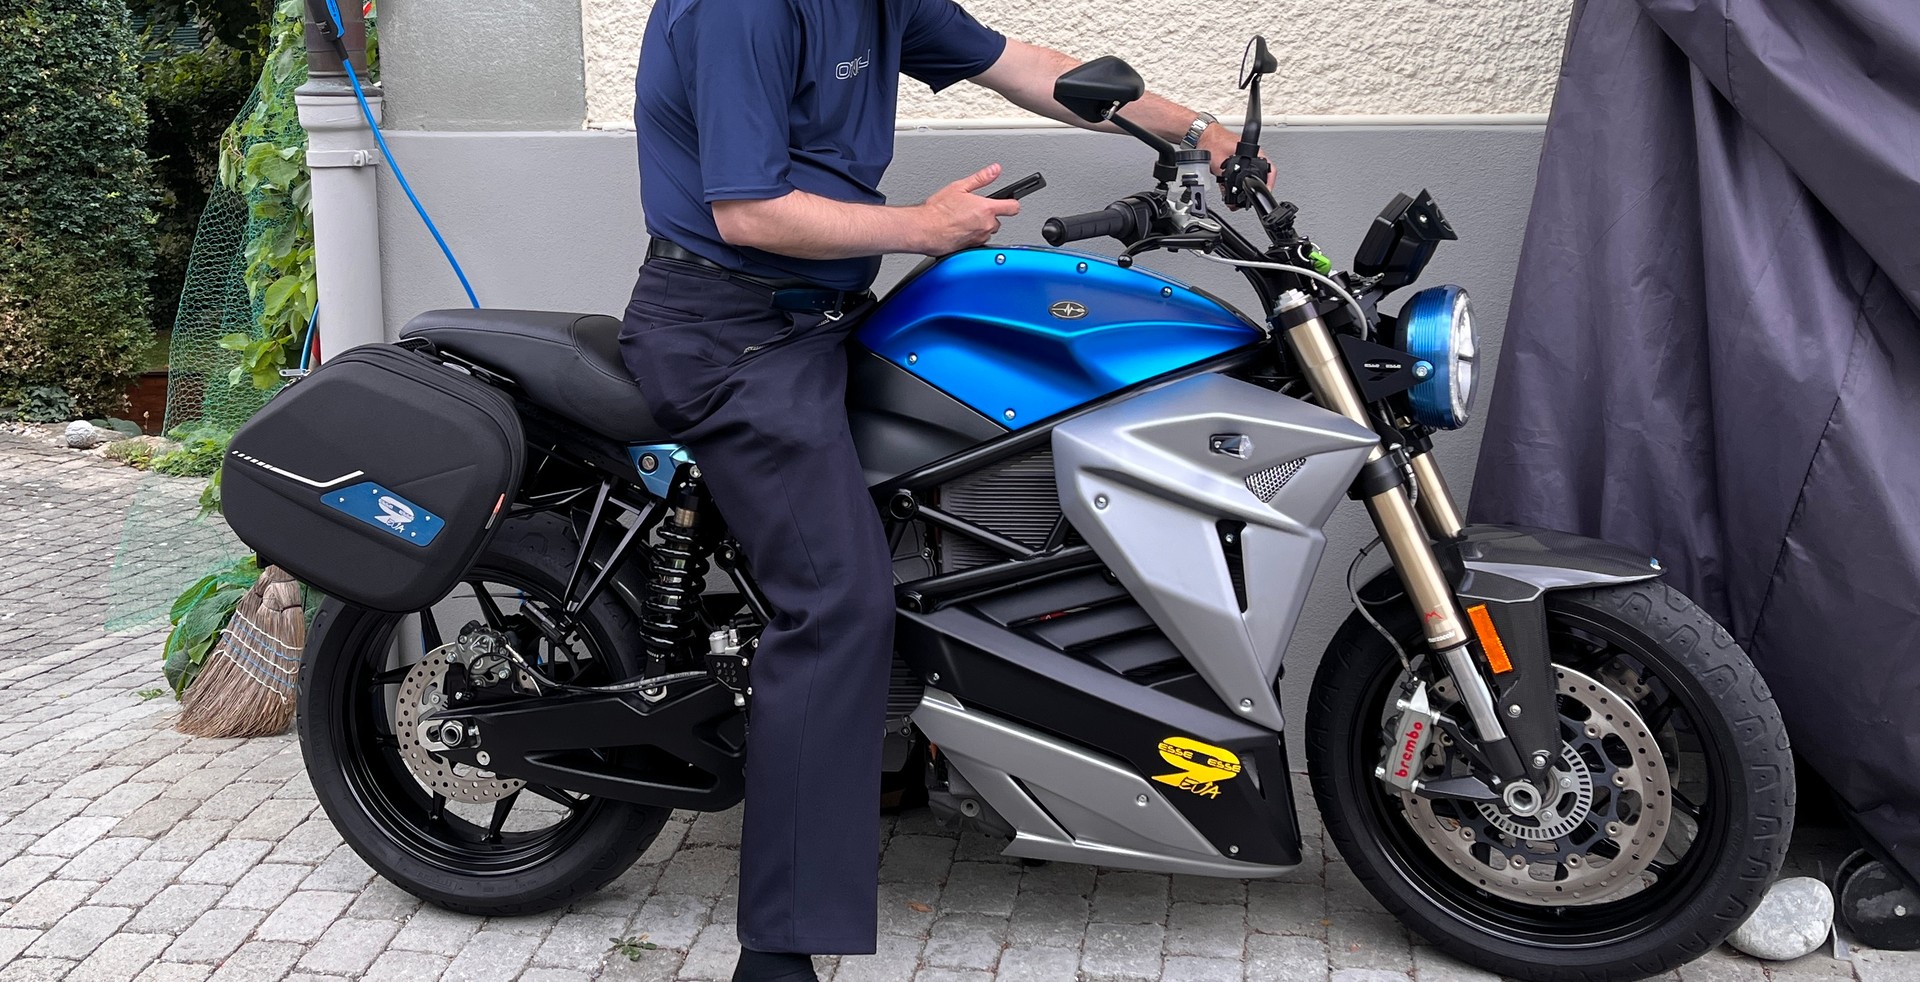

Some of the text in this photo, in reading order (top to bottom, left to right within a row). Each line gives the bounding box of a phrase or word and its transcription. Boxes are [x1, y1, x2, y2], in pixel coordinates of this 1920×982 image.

[1157, 742, 1242, 774] ESSE ESSE
[1394, 721, 1423, 778] brembo
